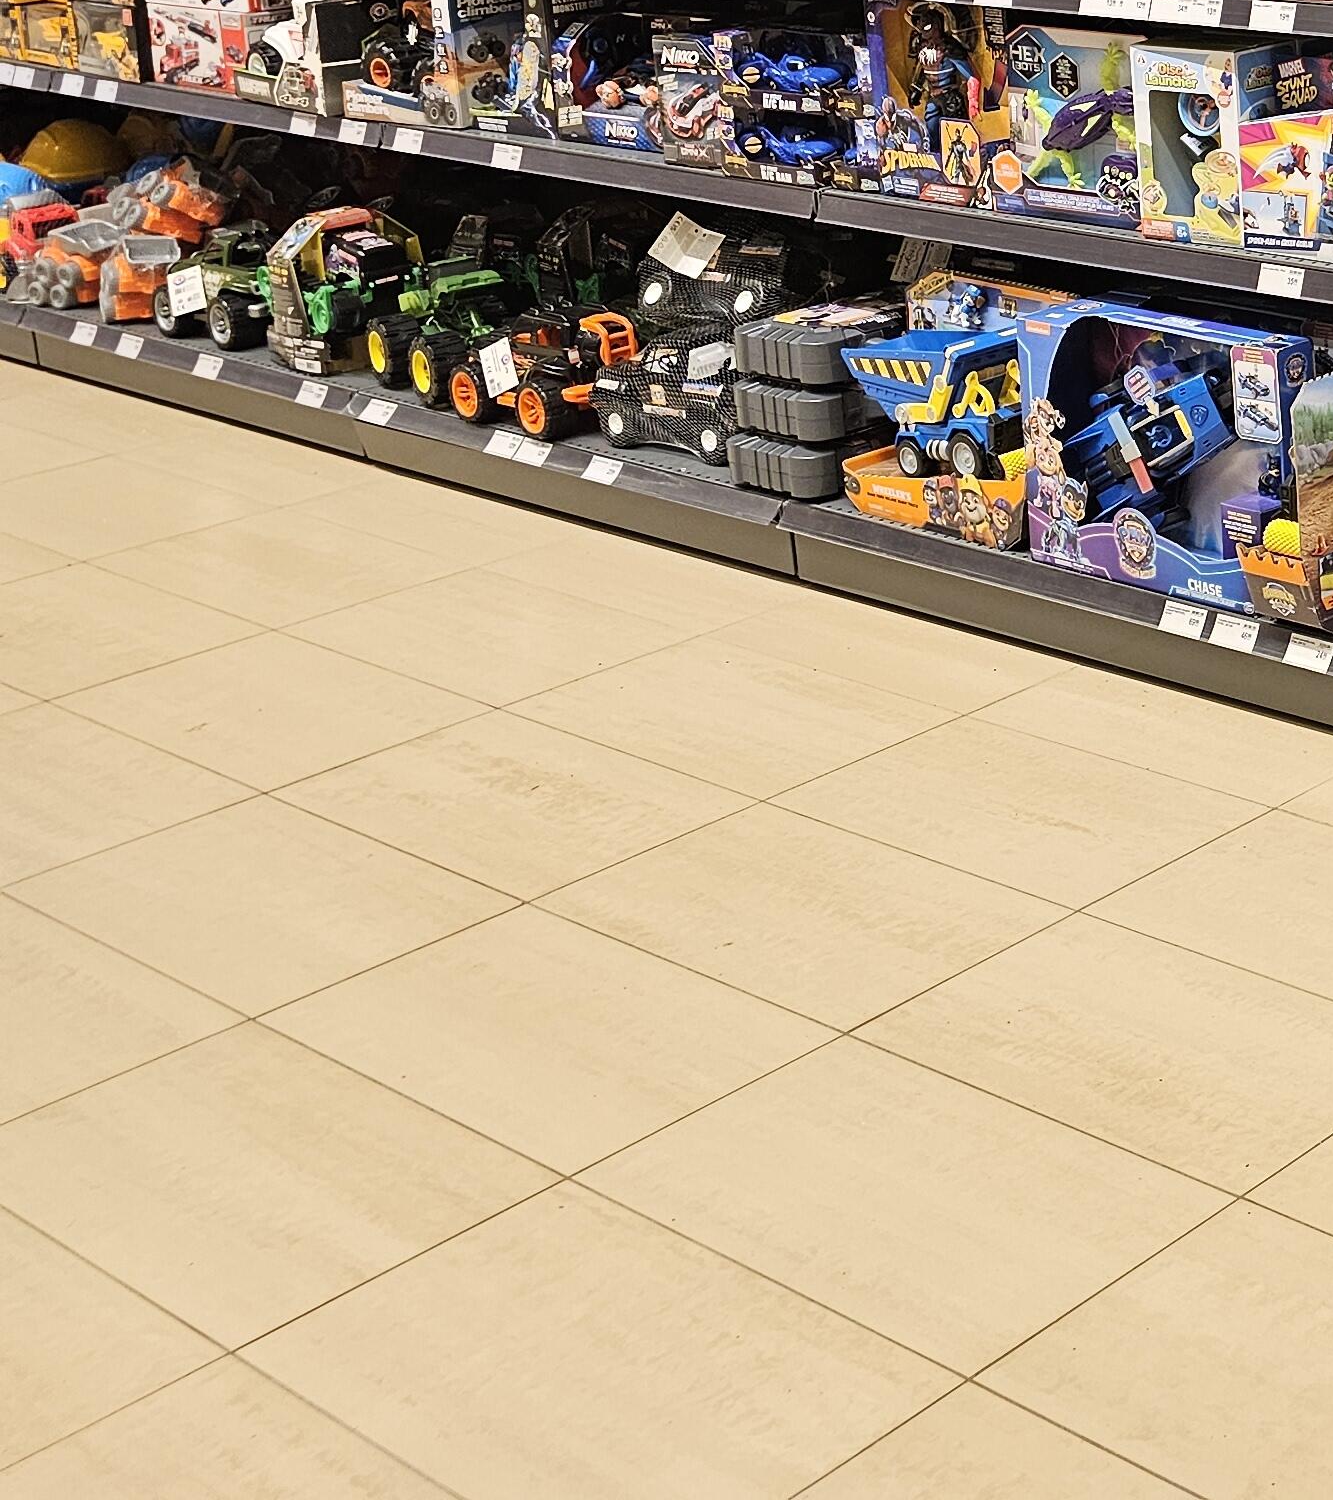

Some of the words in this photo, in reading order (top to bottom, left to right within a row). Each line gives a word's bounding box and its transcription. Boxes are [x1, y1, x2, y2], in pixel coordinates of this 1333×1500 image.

[456, 4, 522, 20] climbers
[1010, 45, 1046, 64] HEX
[1278, 60, 1304, 78] MARVEL
[1145, 74, 1199, 89] Launcher
[1187, 577, 1223, 595] CHASE
